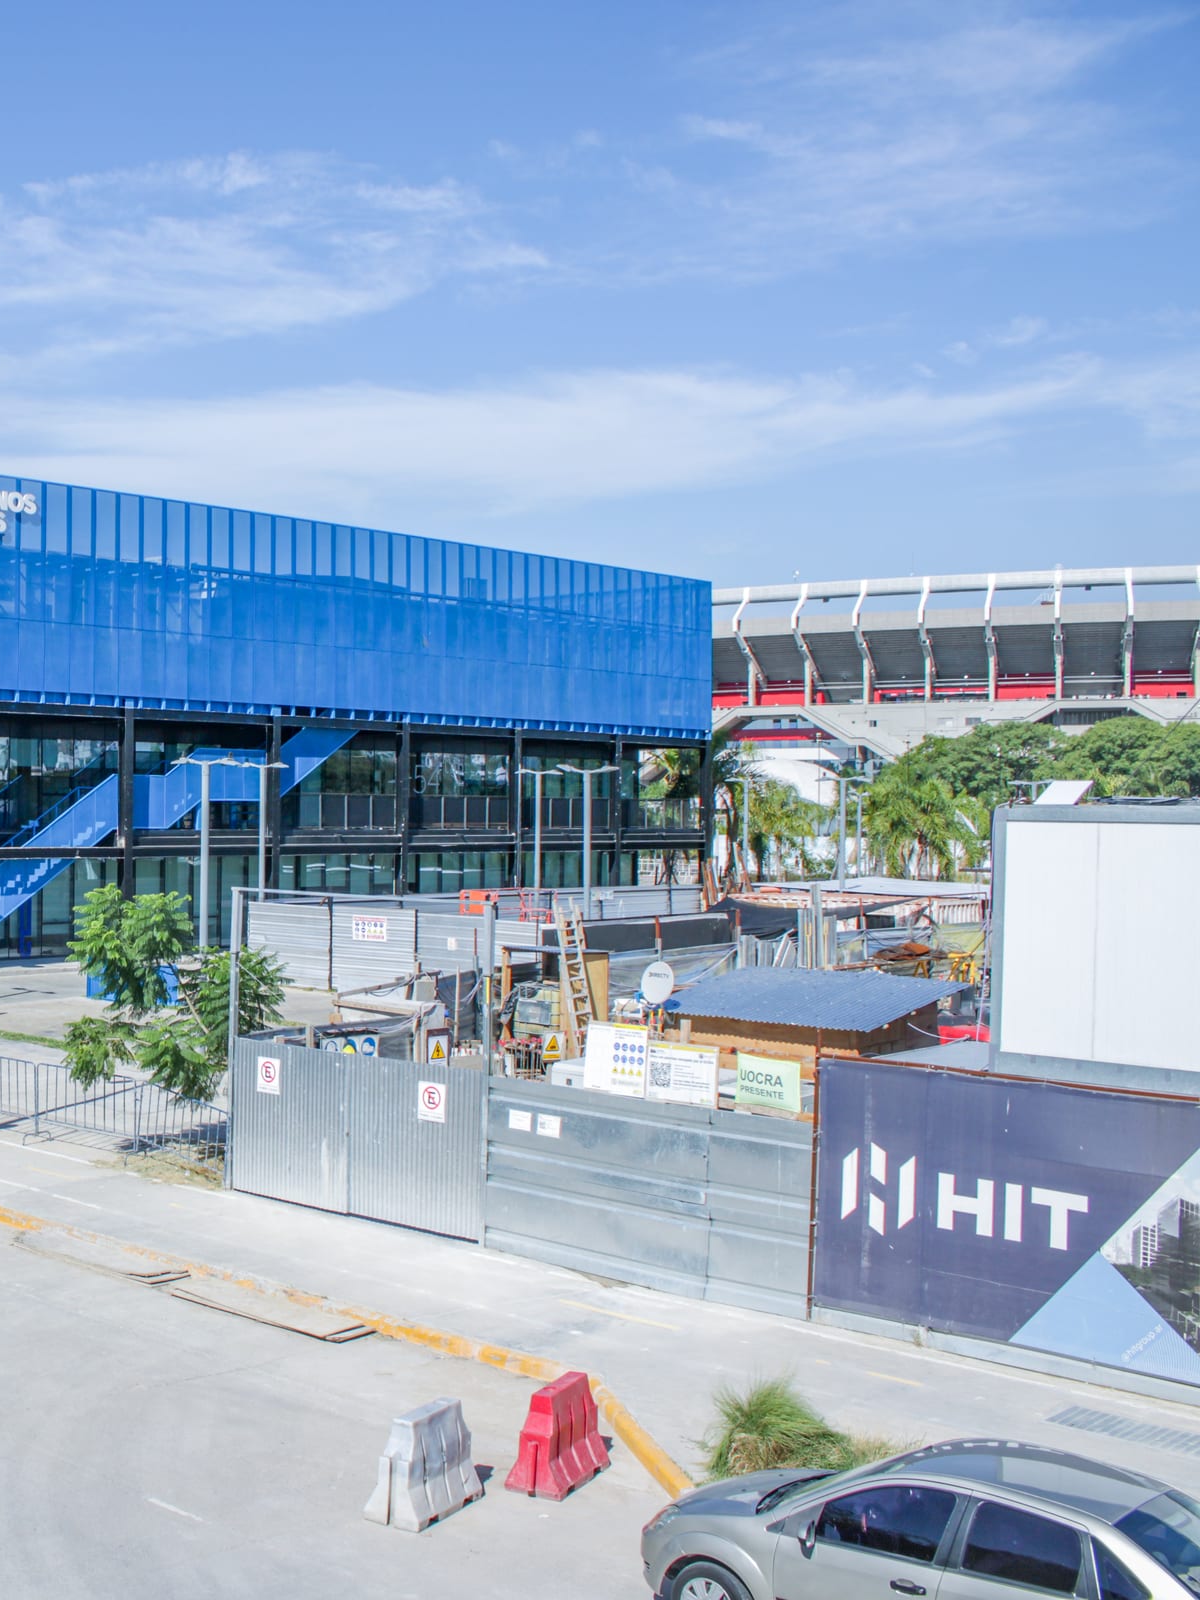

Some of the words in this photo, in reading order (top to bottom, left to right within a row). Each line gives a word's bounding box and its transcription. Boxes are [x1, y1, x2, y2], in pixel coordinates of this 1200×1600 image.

[740, 1068, 784, 1088] UOCRA
[740, 1084, 784, 1100] PRESENTE
[937, 1172, 1089, 1251] HIT
